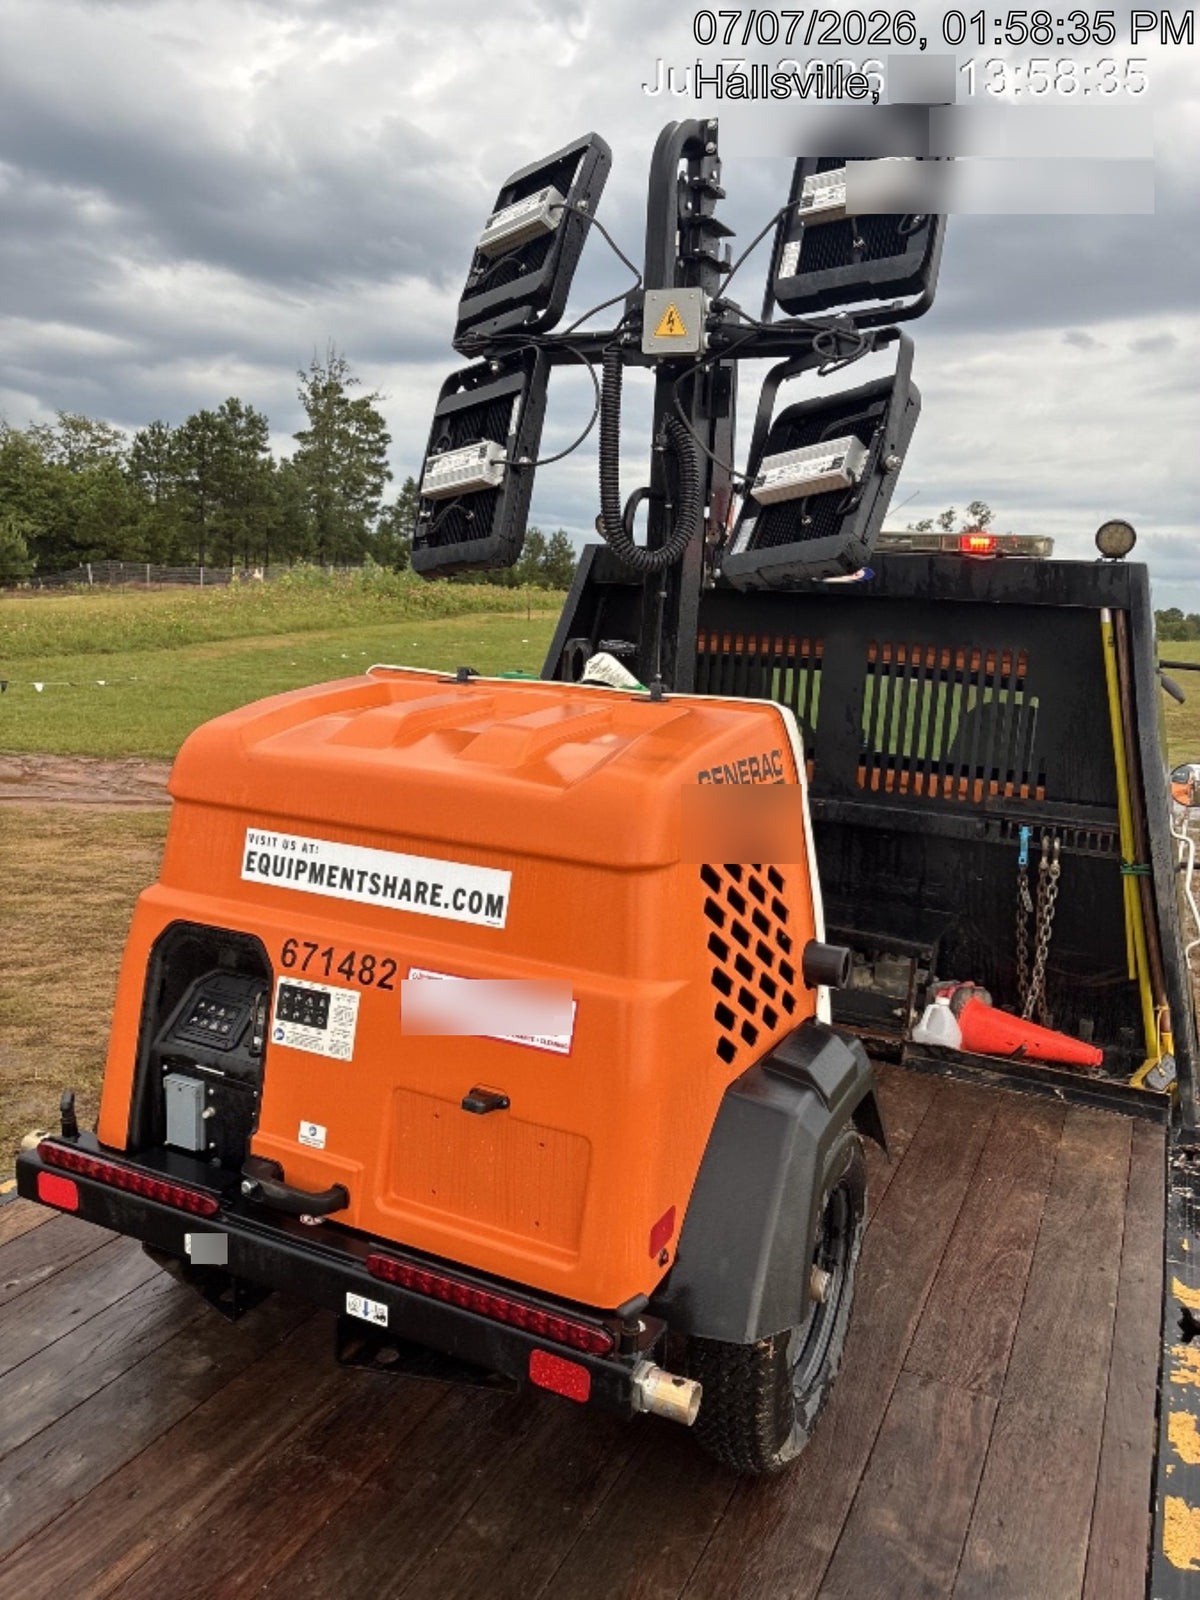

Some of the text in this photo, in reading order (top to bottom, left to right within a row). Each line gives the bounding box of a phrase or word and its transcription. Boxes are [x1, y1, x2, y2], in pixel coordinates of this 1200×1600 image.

[248, 833, 278, 848] VISIT
[282, 838, 296, 850] US
[245, 850, 505, 919] EQUIPMENTSHARE.COM
[280, 938, 397, 991] 671482
